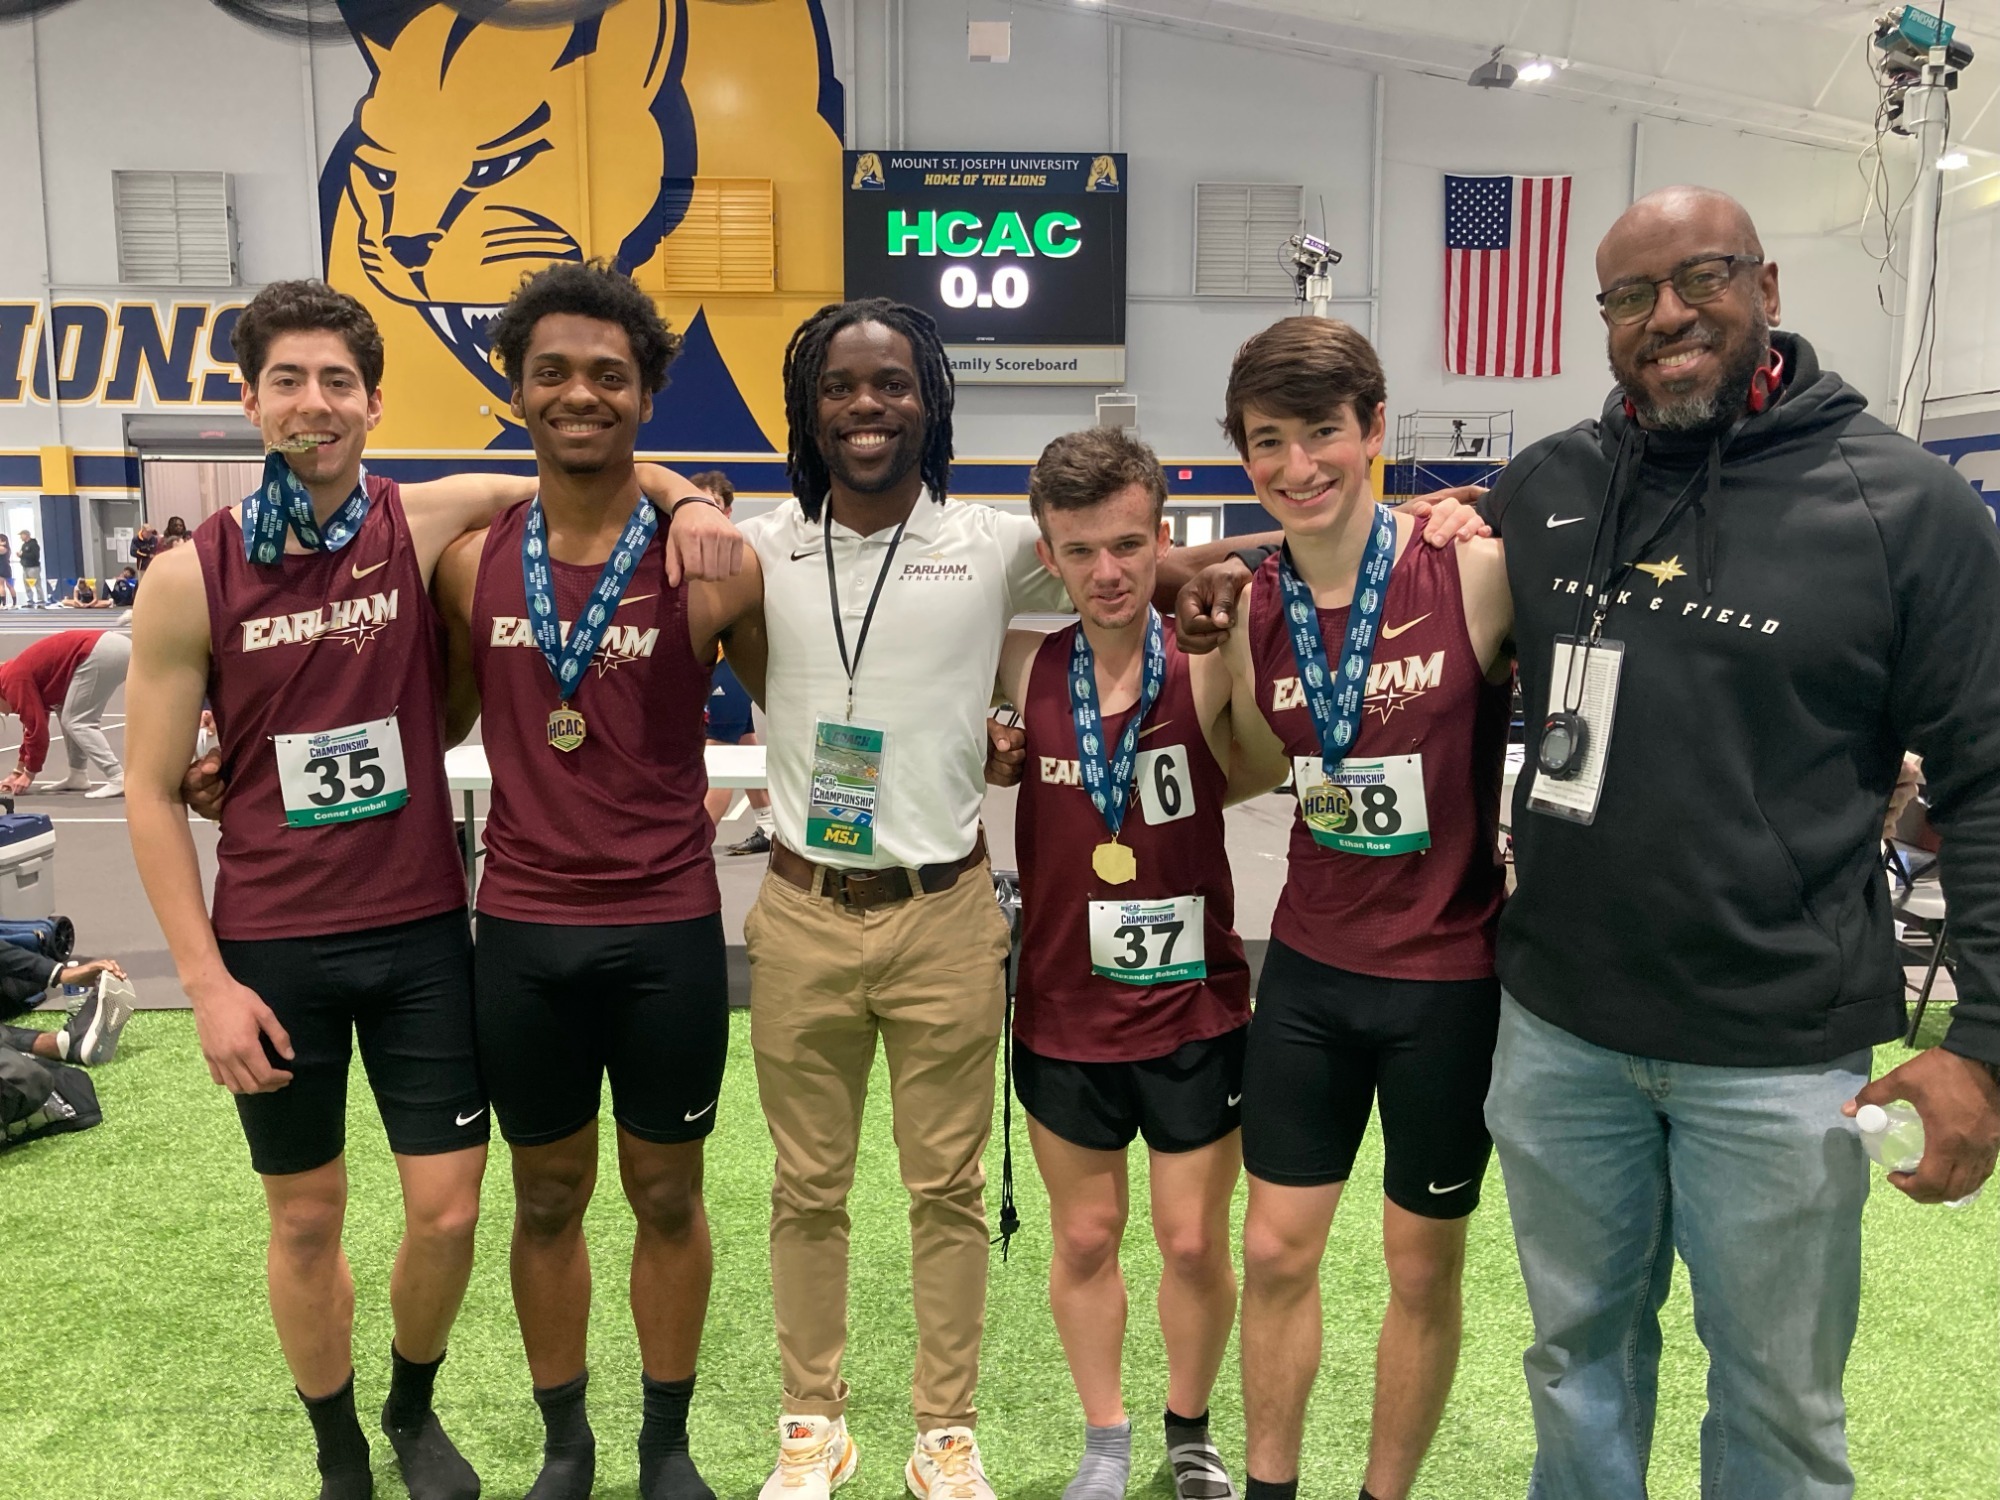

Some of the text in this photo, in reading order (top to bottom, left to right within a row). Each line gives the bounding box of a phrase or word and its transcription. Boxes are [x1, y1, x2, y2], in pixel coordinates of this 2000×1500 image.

[891, 158, 1080, 171] MOUNT ST. JOSEPH UNIVERSITY
[924, 174, 1047, 186] HOME OF THE LIONS
[888, 210, 1081, 258] HCAC
[940, 267, 1029, 308] 0.0
[947, 358, 1078, 373] amily Scoreboard
[903, 564, 968, 575] EARLHAM
[1552, 578, 1780, 635] TRAK & FIELD
[240, 588, 399, 653] EARLHAM
[490, 616, 660, 658] EALAM
[1272, 651, 1445, 712] EAHAM
[549, 718, 583, 741] HCAC
[310, 739, 369, 758] CHAMPIONSHIP
[304, 747, 385, 807] 35
[1154, 754, 1181, 816] 6
[814, 787, 874, 808] CHAMPIONSHIP
[1305, 796, 1346, 816] HCAC
[314, 800, 387, 820] Conner Kimball
[823, 828, 860, 845] MSJ
[1339, 839, 1391, 850] Ethan Rose
[1121, 913, 1176, 924] CHAMPIONSHIP
[1113, 920, 1184, 969] 37
[1110, 968, 1189, 980] Alexander Roberts
